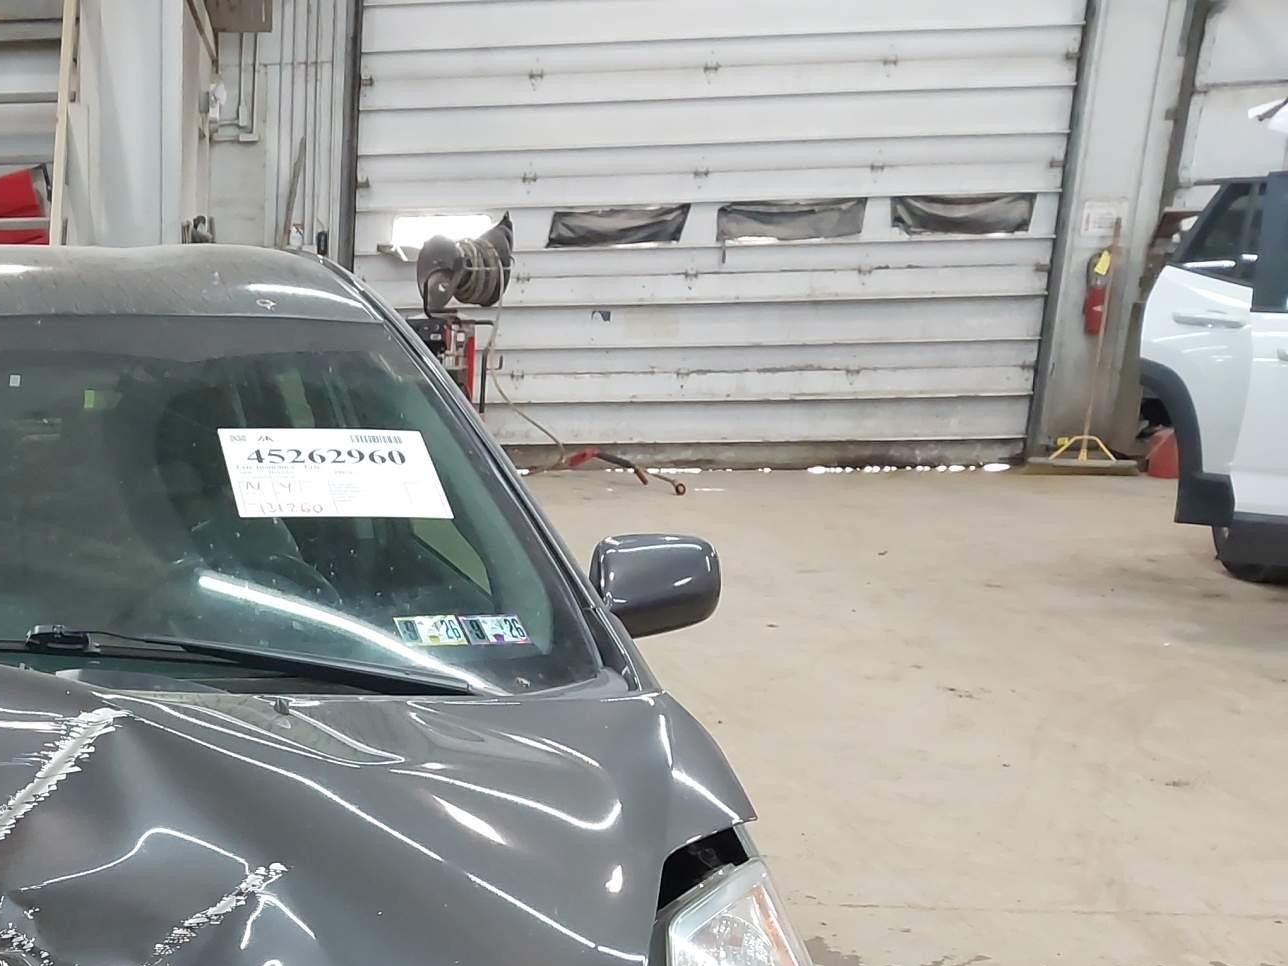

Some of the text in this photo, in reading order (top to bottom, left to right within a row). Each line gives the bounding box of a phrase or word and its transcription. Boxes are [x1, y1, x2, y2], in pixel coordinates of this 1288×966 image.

[247, 448, 406, 465] 45262960
[440, 619, 462, 639] 26
[504, 618, 525, 638] 26
